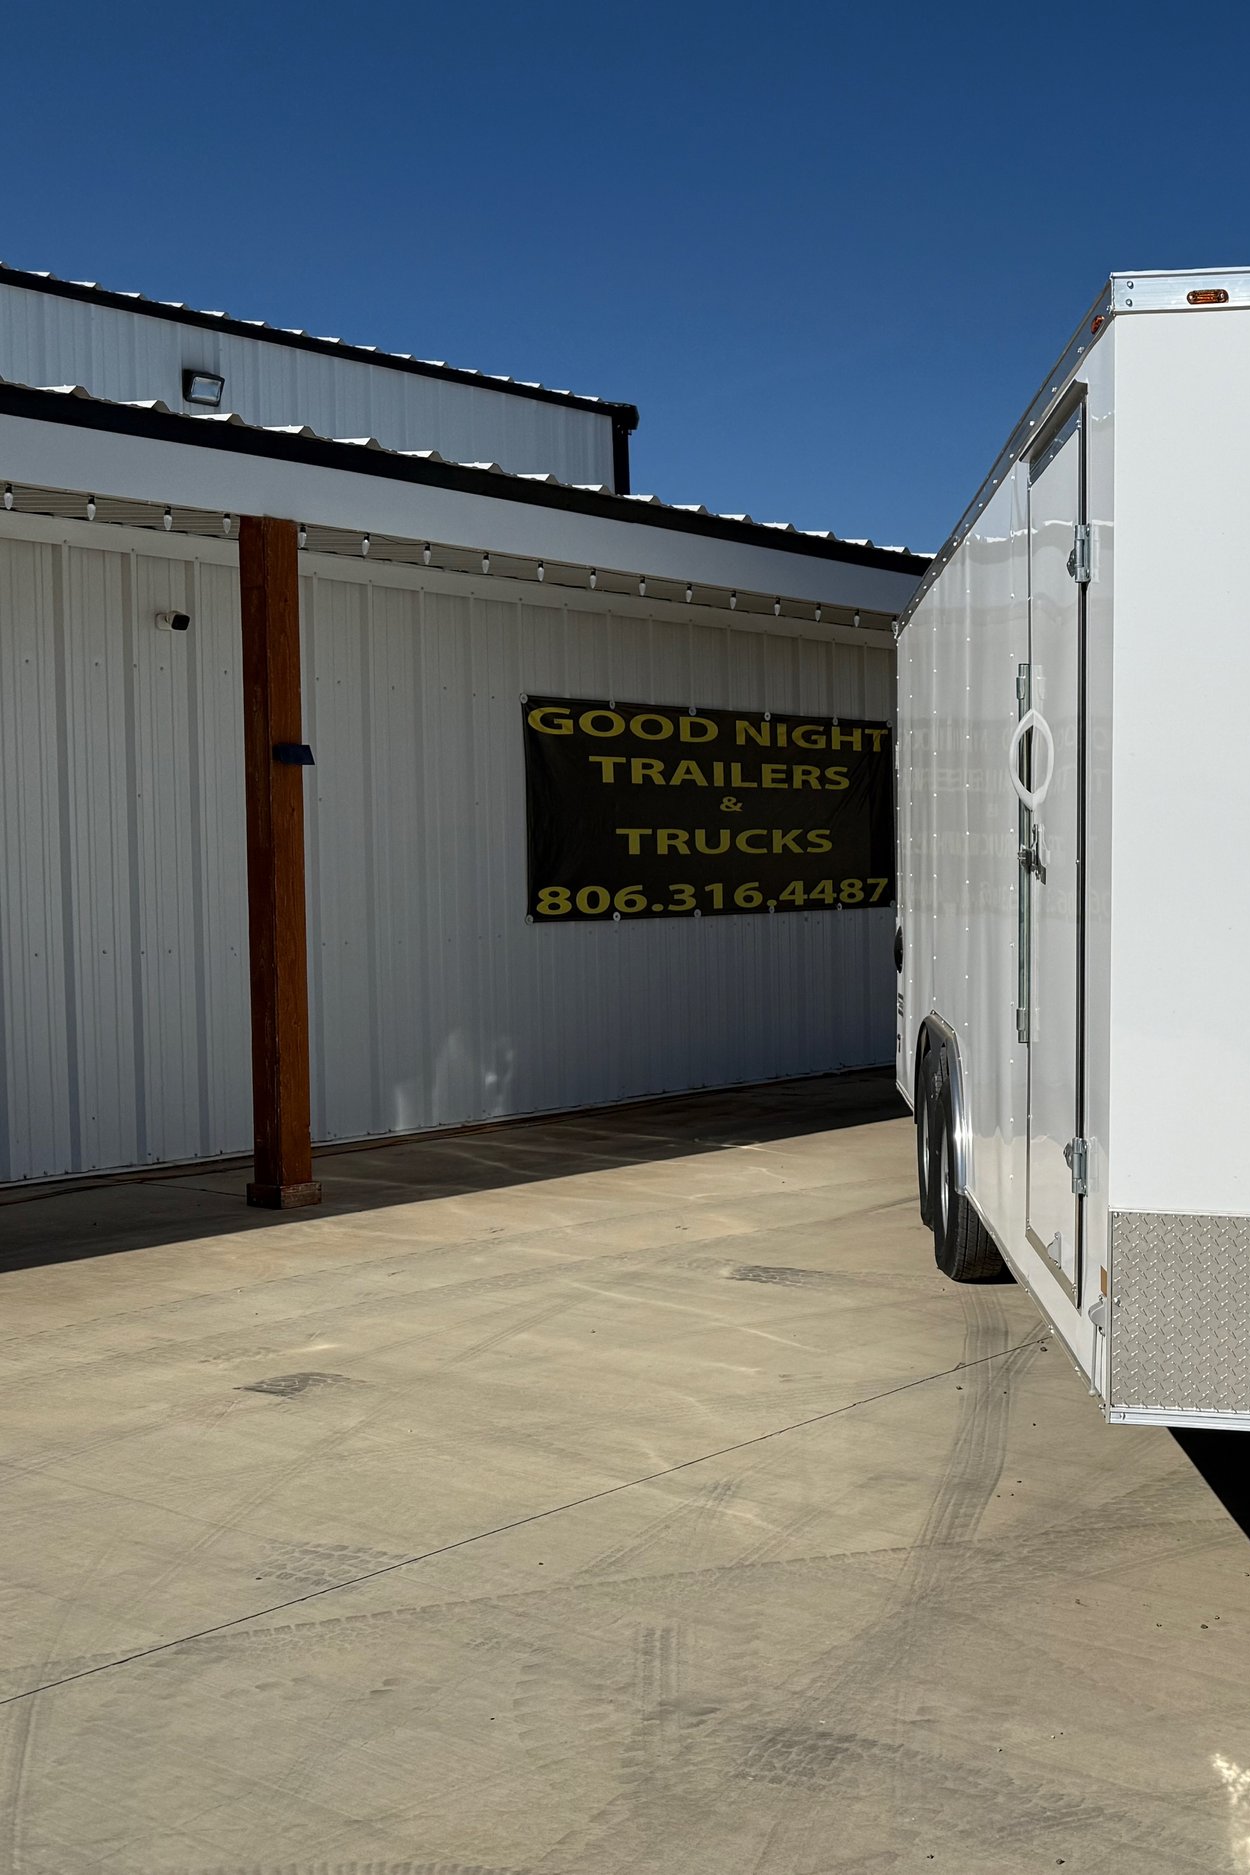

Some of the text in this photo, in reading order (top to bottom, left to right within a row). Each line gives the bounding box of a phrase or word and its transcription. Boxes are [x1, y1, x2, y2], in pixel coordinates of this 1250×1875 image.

[527, 707, 888, 752] GOOD NIGHT
[589, 756, 850, 790] TRAILERS
[719, 796, 743, 812] &
[616, 828, 833, 855] TRUCKS
[536, 877, 889, 915] 806.316.4487
